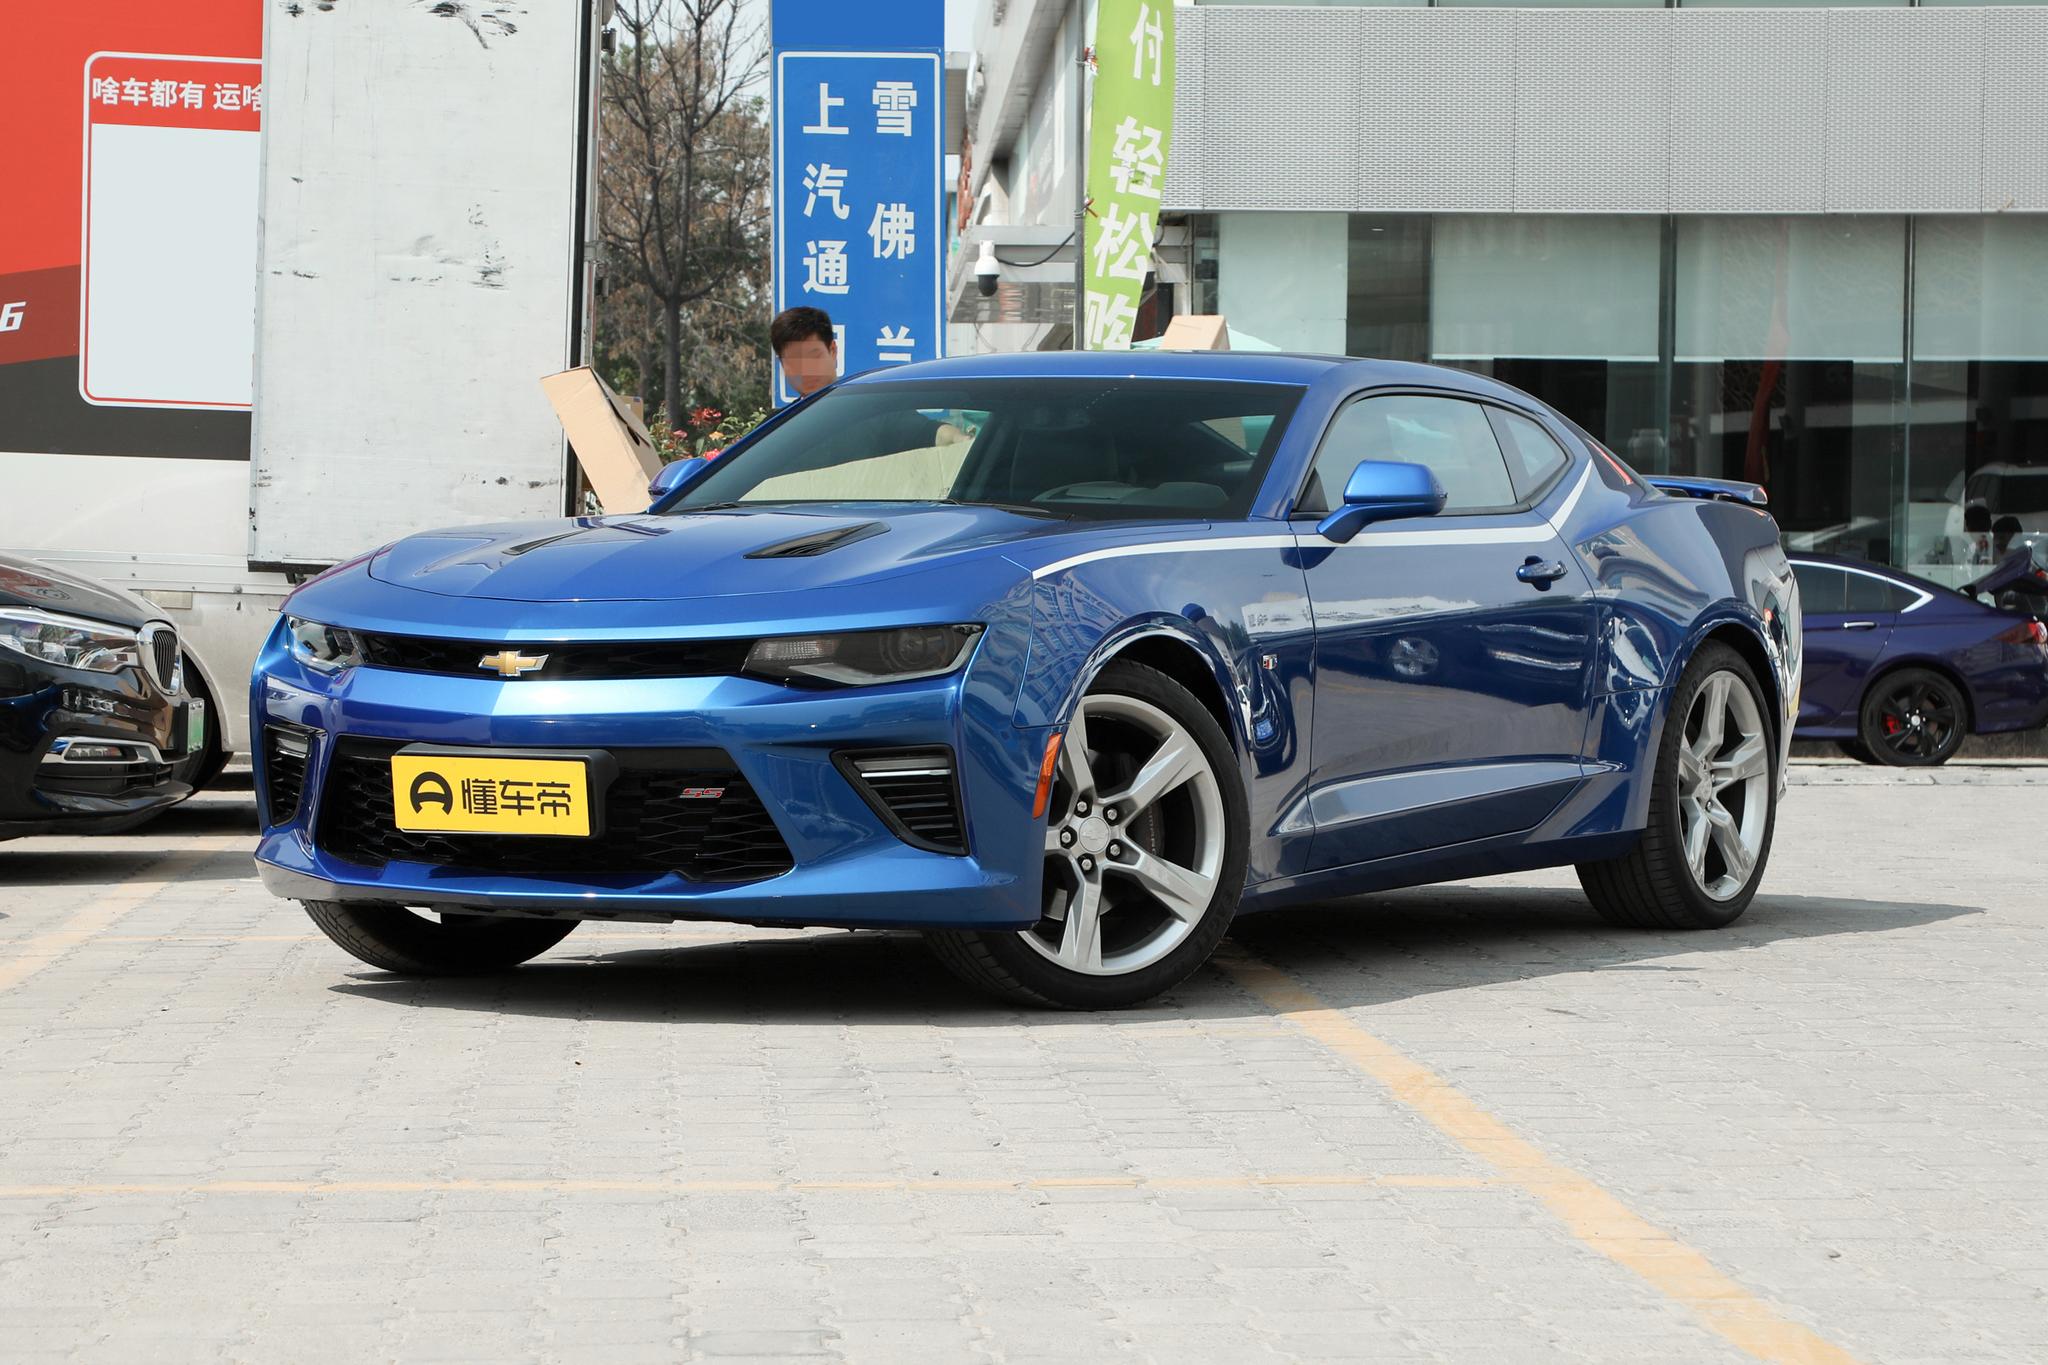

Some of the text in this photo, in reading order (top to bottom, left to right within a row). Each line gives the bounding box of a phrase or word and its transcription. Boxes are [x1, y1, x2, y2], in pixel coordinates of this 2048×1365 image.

[1129, 2, 1164, 86] 付
[92, 76, 206, 109] 啥车都有
[802, 82, 850, 377] 上汽通
[460, 778, 571, 817] 懂车帝
[679, 787, 725, 799] SS
